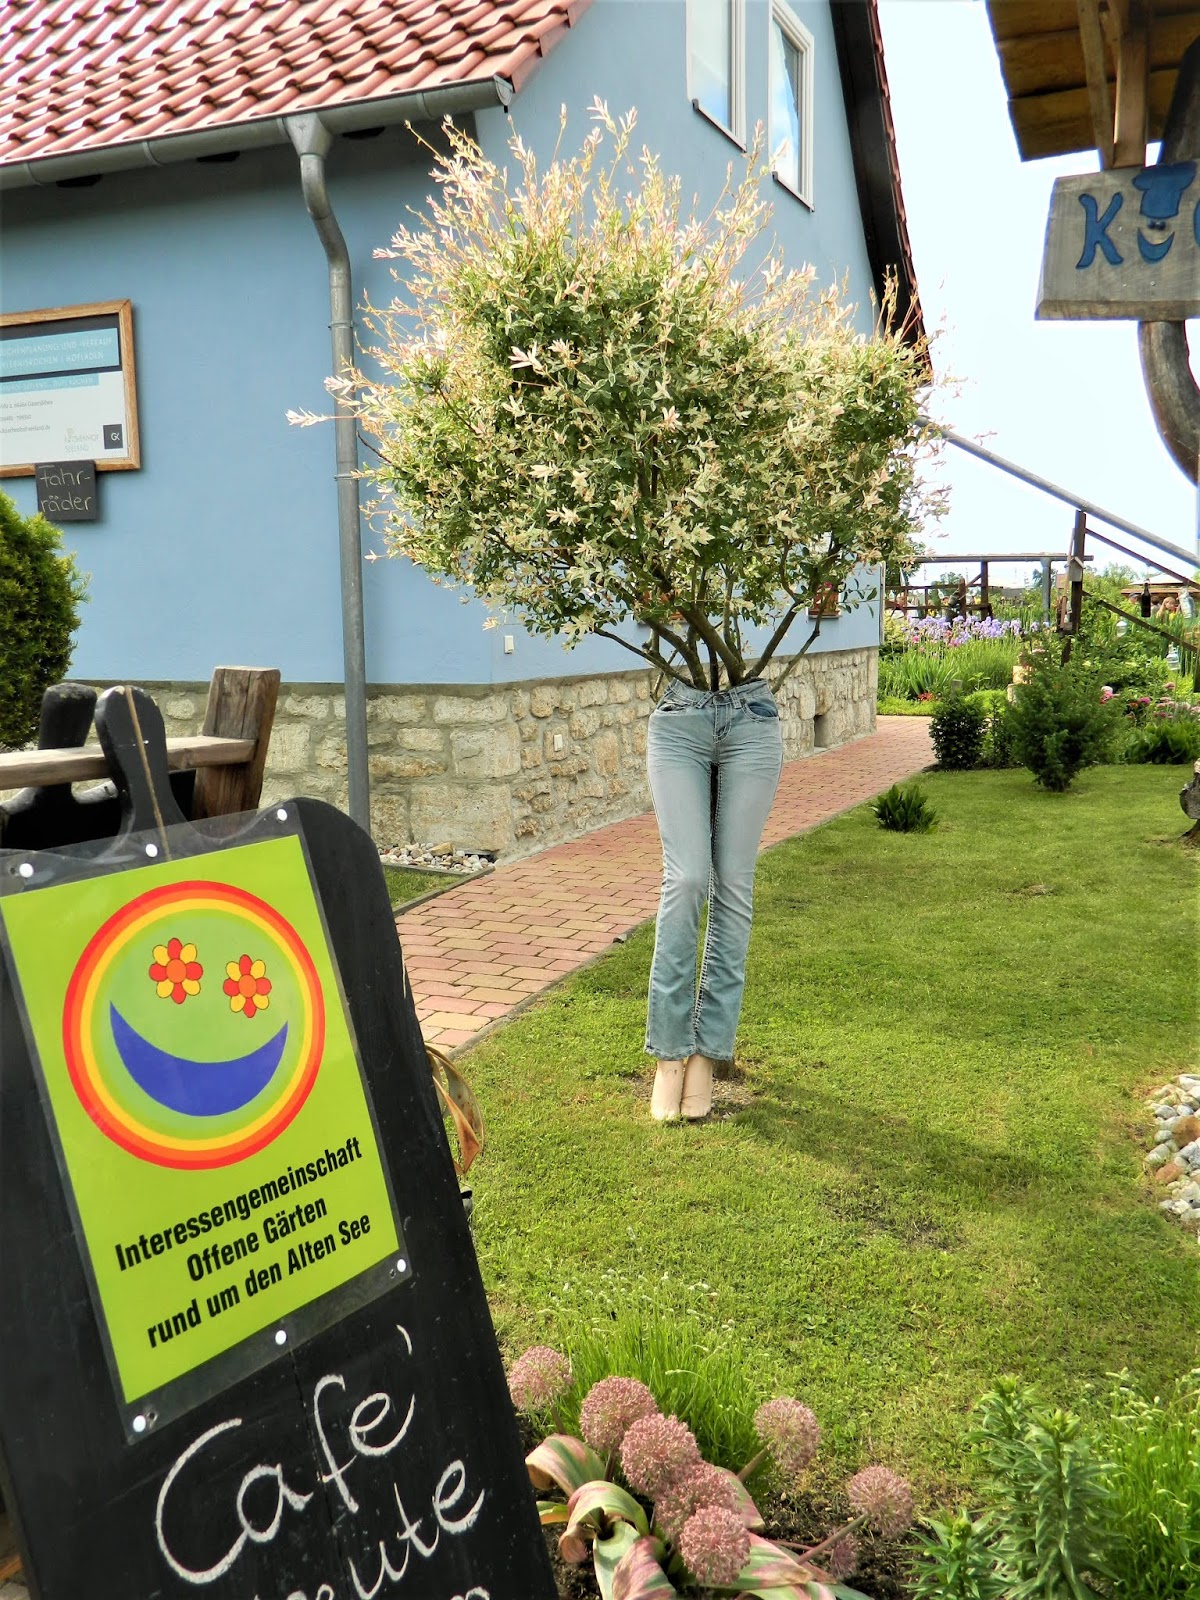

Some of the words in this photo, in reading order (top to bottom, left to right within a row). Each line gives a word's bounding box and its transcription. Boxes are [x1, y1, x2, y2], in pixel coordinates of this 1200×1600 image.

[40, 491, 92, 512] räder
[114, 1136, 362, 1271] Interessengemeinschaft
[187, 1231, 260, 1282] Offene
[263, 1197, 328, 1244] Gärten
[147, 1299, 202, 1348] rund
[206, 1285, 241, 1317] um
[244, 1262, 283, 1298] den
[287, 1234, 337, 1276] Alten
[338, 1213, 371, 1246] See
[253, 1459, 485, 1600] ute
